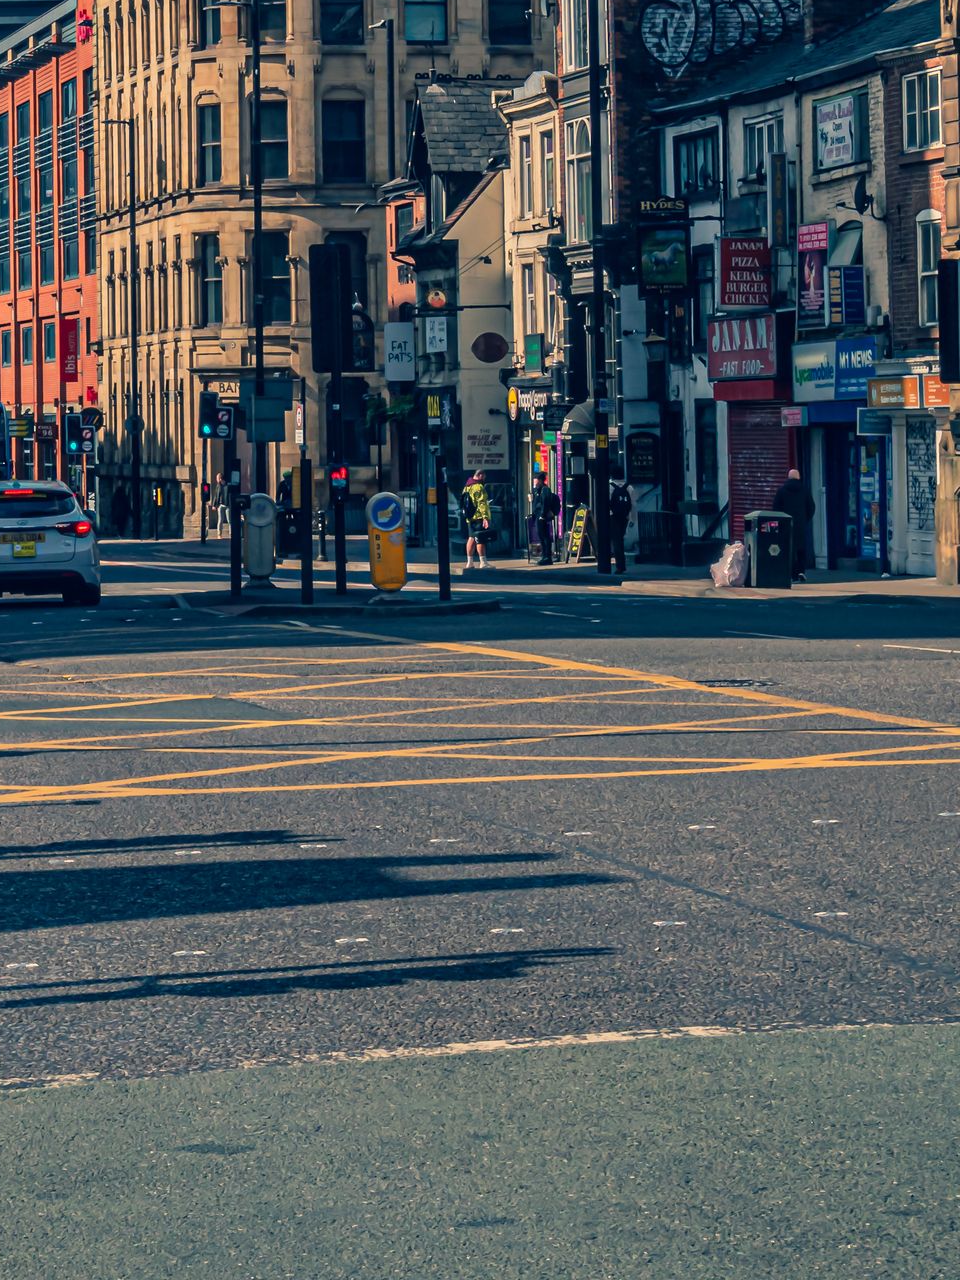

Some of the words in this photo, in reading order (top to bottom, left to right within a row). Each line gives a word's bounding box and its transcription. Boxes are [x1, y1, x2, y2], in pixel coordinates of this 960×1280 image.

[832, 122, 843, 132] Open
[640, 198, 685, 210] HYDES
[730, 241, 763, 250] JANAM
[732, 257, 760, 267] PIZZA
[730, 270, 764, 281] KEBAB
[726, 282, 768, 293] BURGER
[724, 294, 769, 304] CHICKEN
[711, 317, 768, 353] JANAM
[391, 340, 408, 352] FAT
[388, 352, 413, 362] PAT'S
[839, 351, 850, 369] M1
[851, 348, 873, 369] NEWS
[64, 354, 76, 373] ibis
[795, 363, 834, 386] Lycamobile
